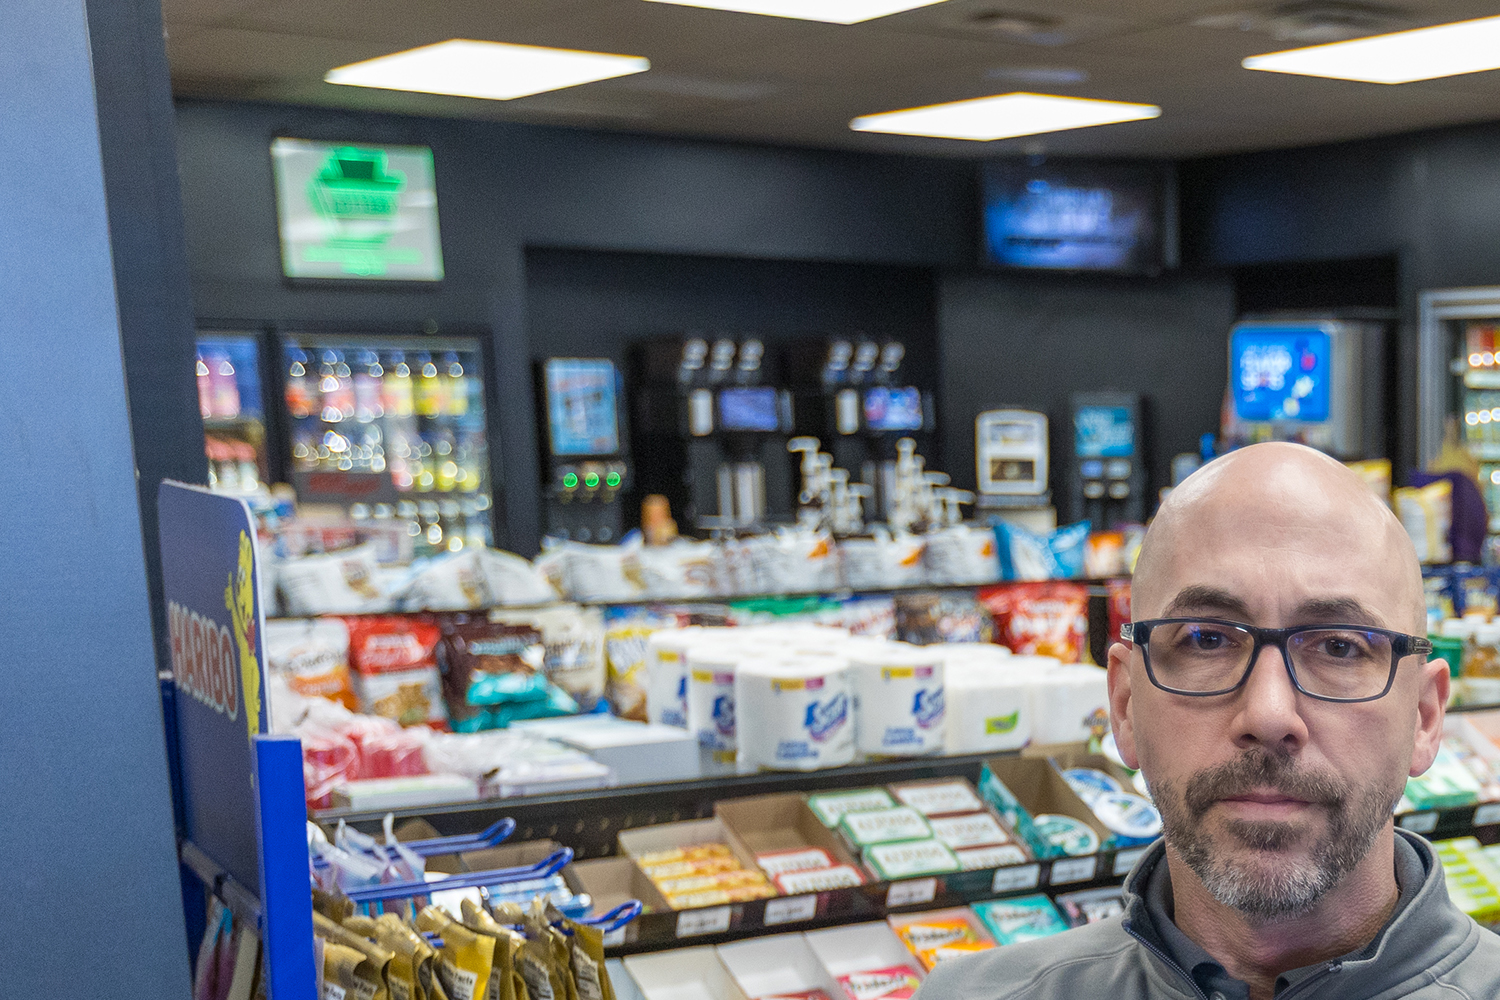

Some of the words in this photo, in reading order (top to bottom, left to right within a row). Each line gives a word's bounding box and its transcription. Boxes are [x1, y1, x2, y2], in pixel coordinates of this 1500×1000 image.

[168, 599, 239, 722] HARIBO
[904, 926, 966, 944] Trident
[843, 973, 908, 992] Trident
